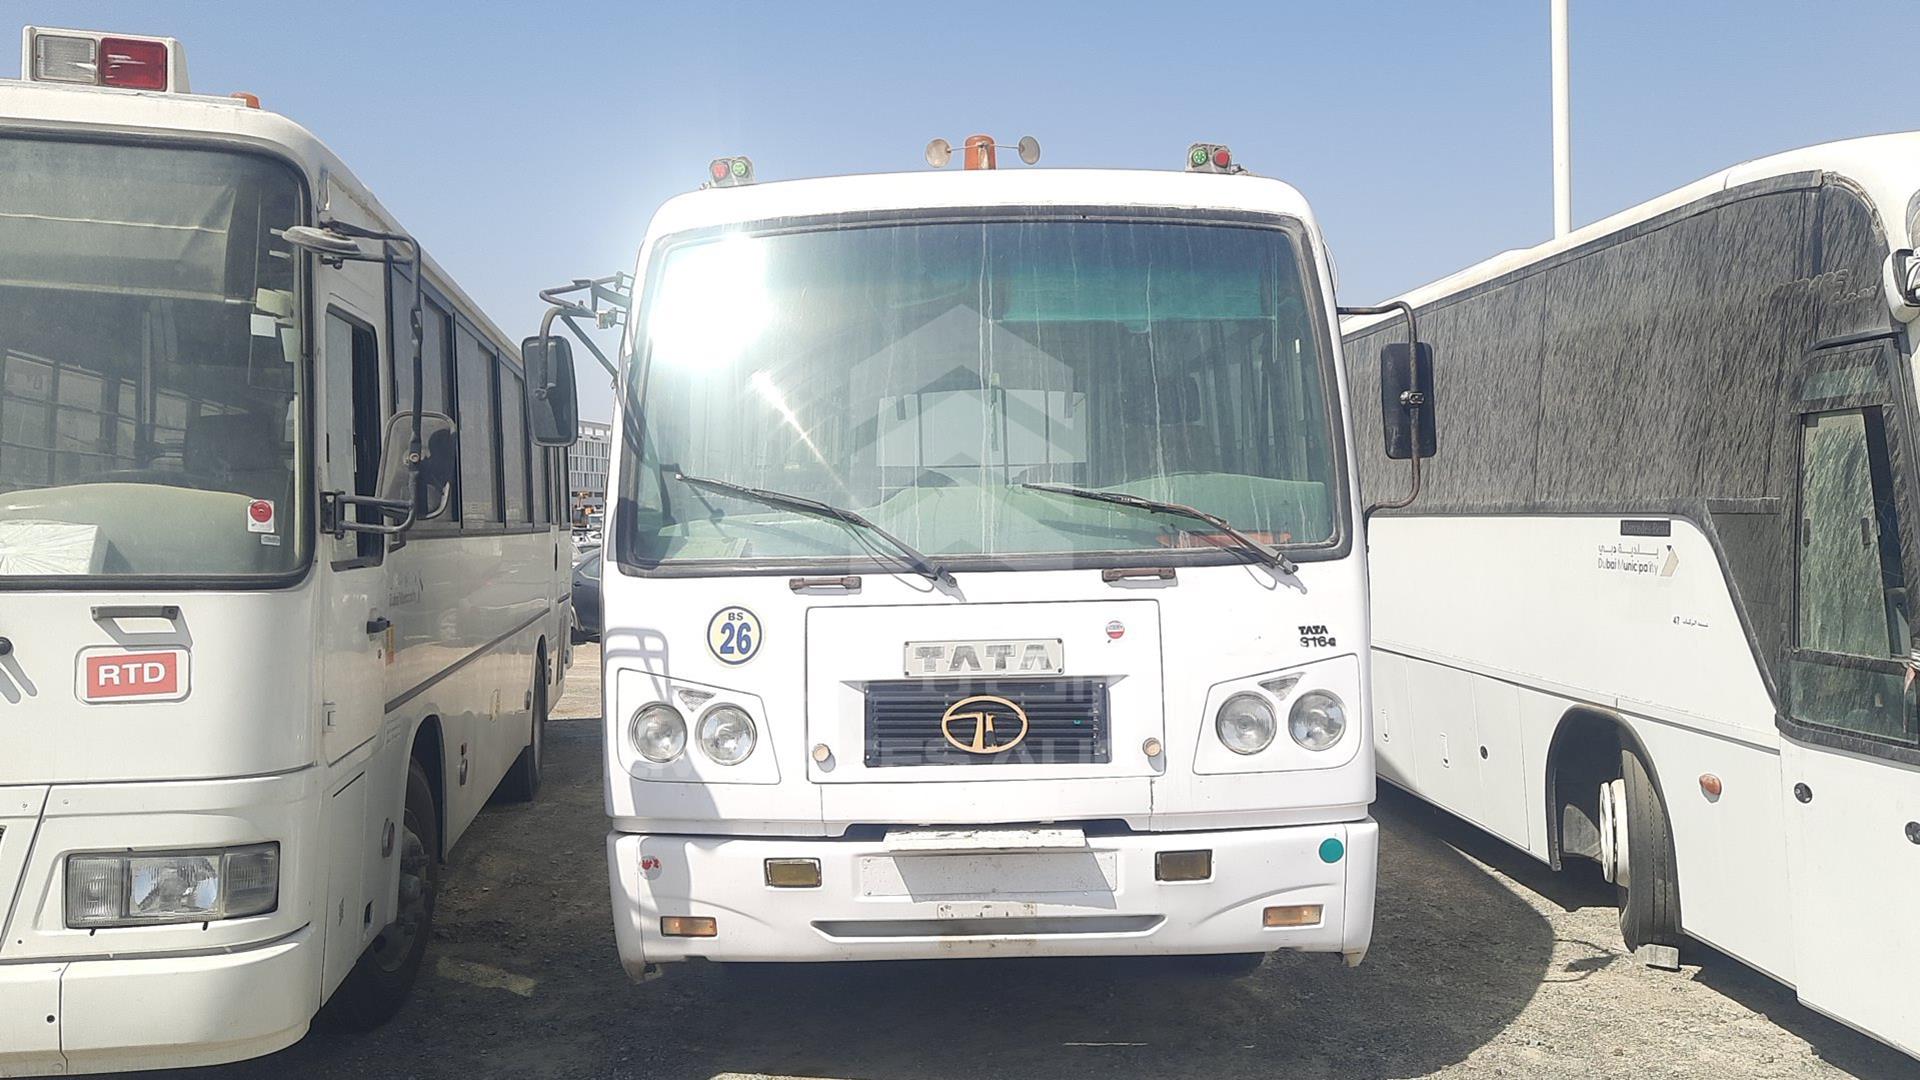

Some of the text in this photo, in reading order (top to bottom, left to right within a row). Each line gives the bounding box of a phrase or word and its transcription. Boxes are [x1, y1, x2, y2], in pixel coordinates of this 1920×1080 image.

[1598, 557, 1659, 575] Dubai Municipality
[727, 612, 744, 621] BS
[720, 622, 751, 655] 26
[1298, 625, 1329, 635] TATA
[914, 644, 1053, 673] TATA
[97, 662, 166, 687] RTD
